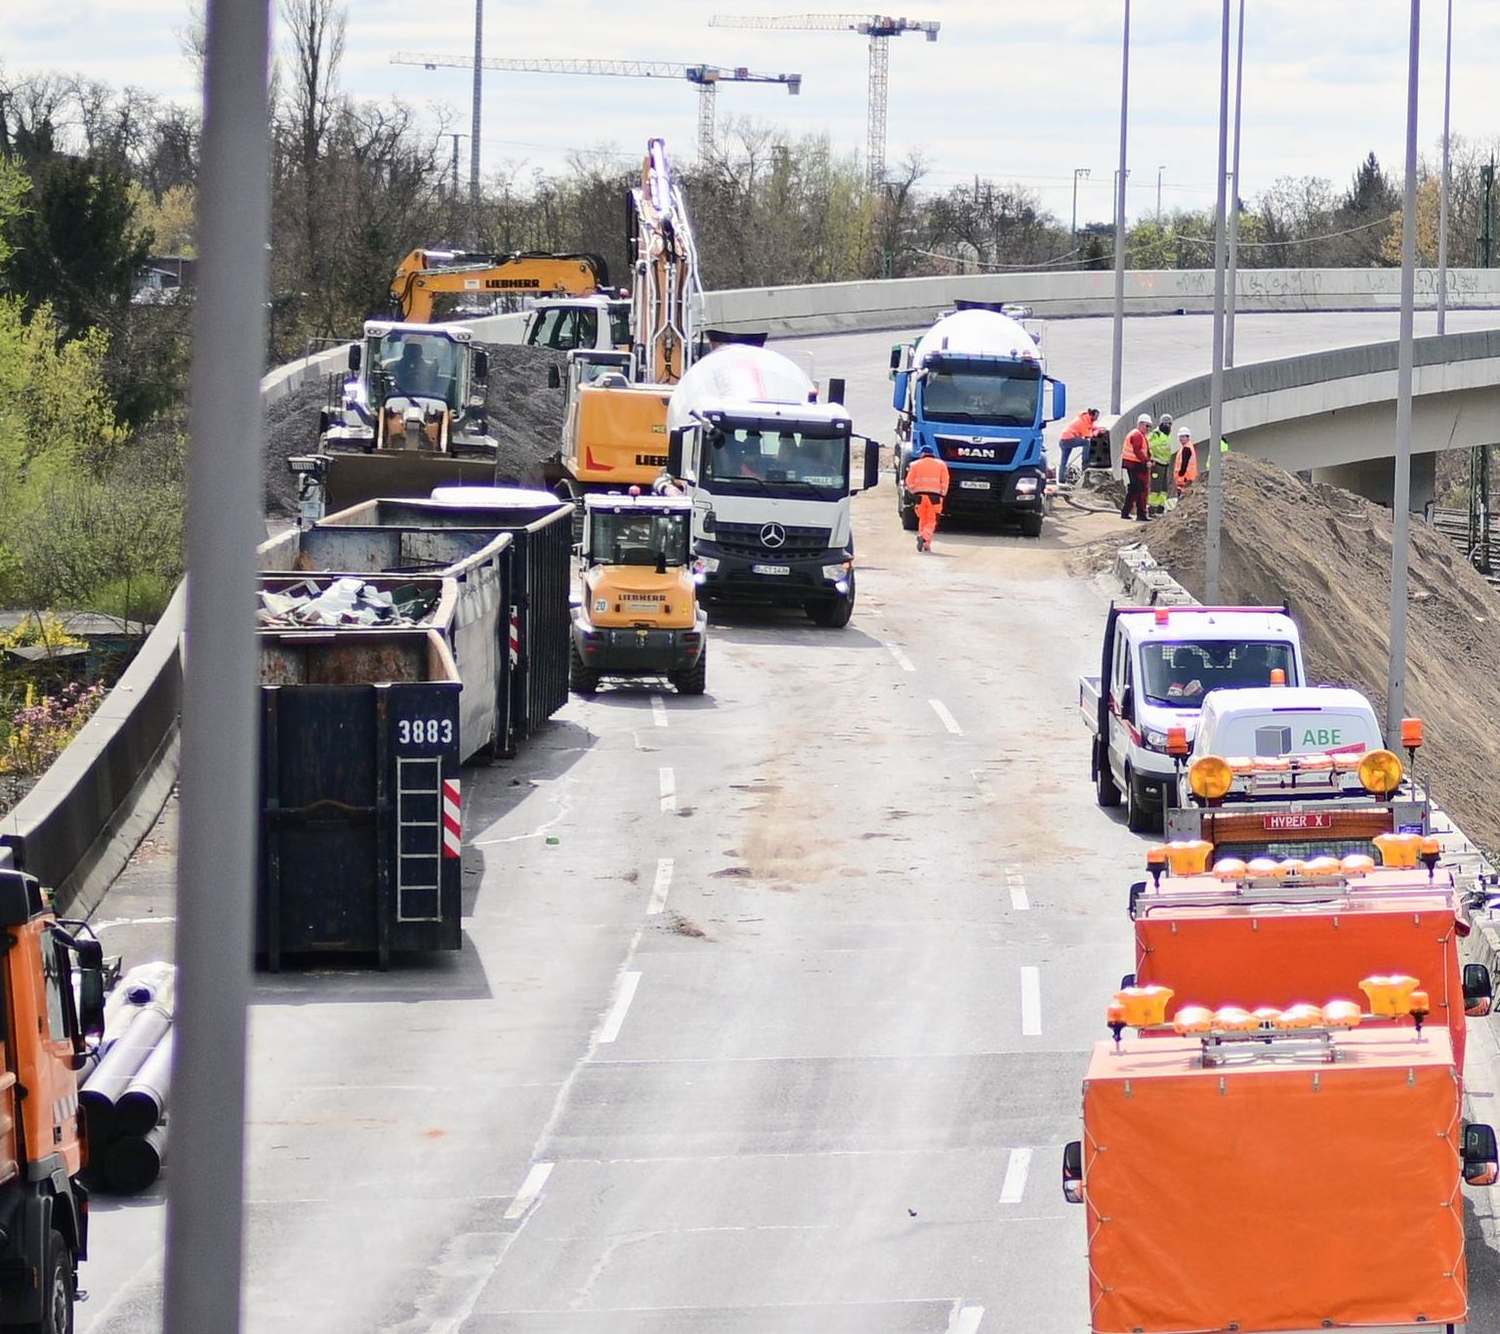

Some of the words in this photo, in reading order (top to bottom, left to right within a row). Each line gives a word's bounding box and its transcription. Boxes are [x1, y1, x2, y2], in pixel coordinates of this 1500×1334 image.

[485, 279, 540, 288] LIEBHERR
[958, 448, 995, 458] MAN
[618, 594, 666, 602] LIEBHERR
[595, 601, 606, 611] 20
[398, 719, 453, 744] 3883
[1302, 729, 1342, 746] ABE
[1271, 815, 1307, 828] HYPER
[1314, 815, 1324, 827] X
